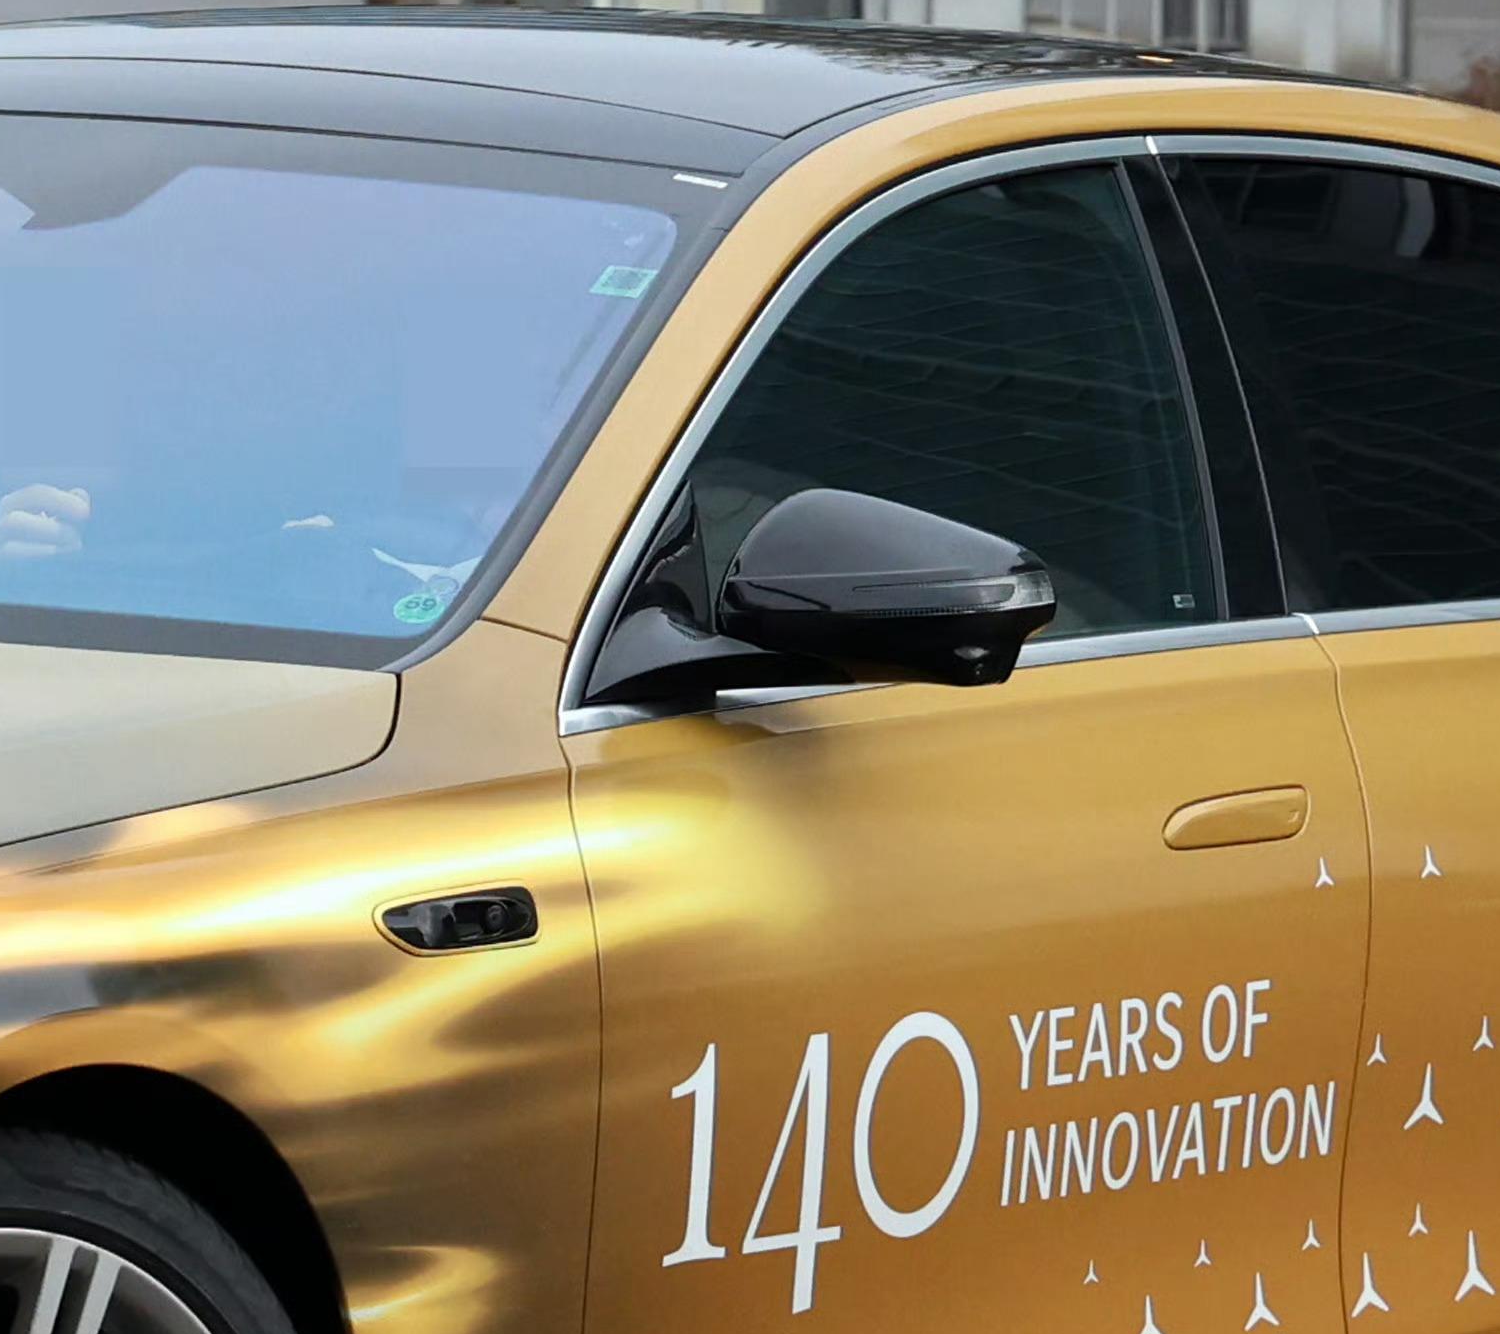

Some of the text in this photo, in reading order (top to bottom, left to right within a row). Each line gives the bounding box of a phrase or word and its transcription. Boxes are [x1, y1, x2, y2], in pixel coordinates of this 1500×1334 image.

[661, 979, 1272, 1315] 140 YEARS OF
[1000, 1080, 1336, 1208] INNOVATION
